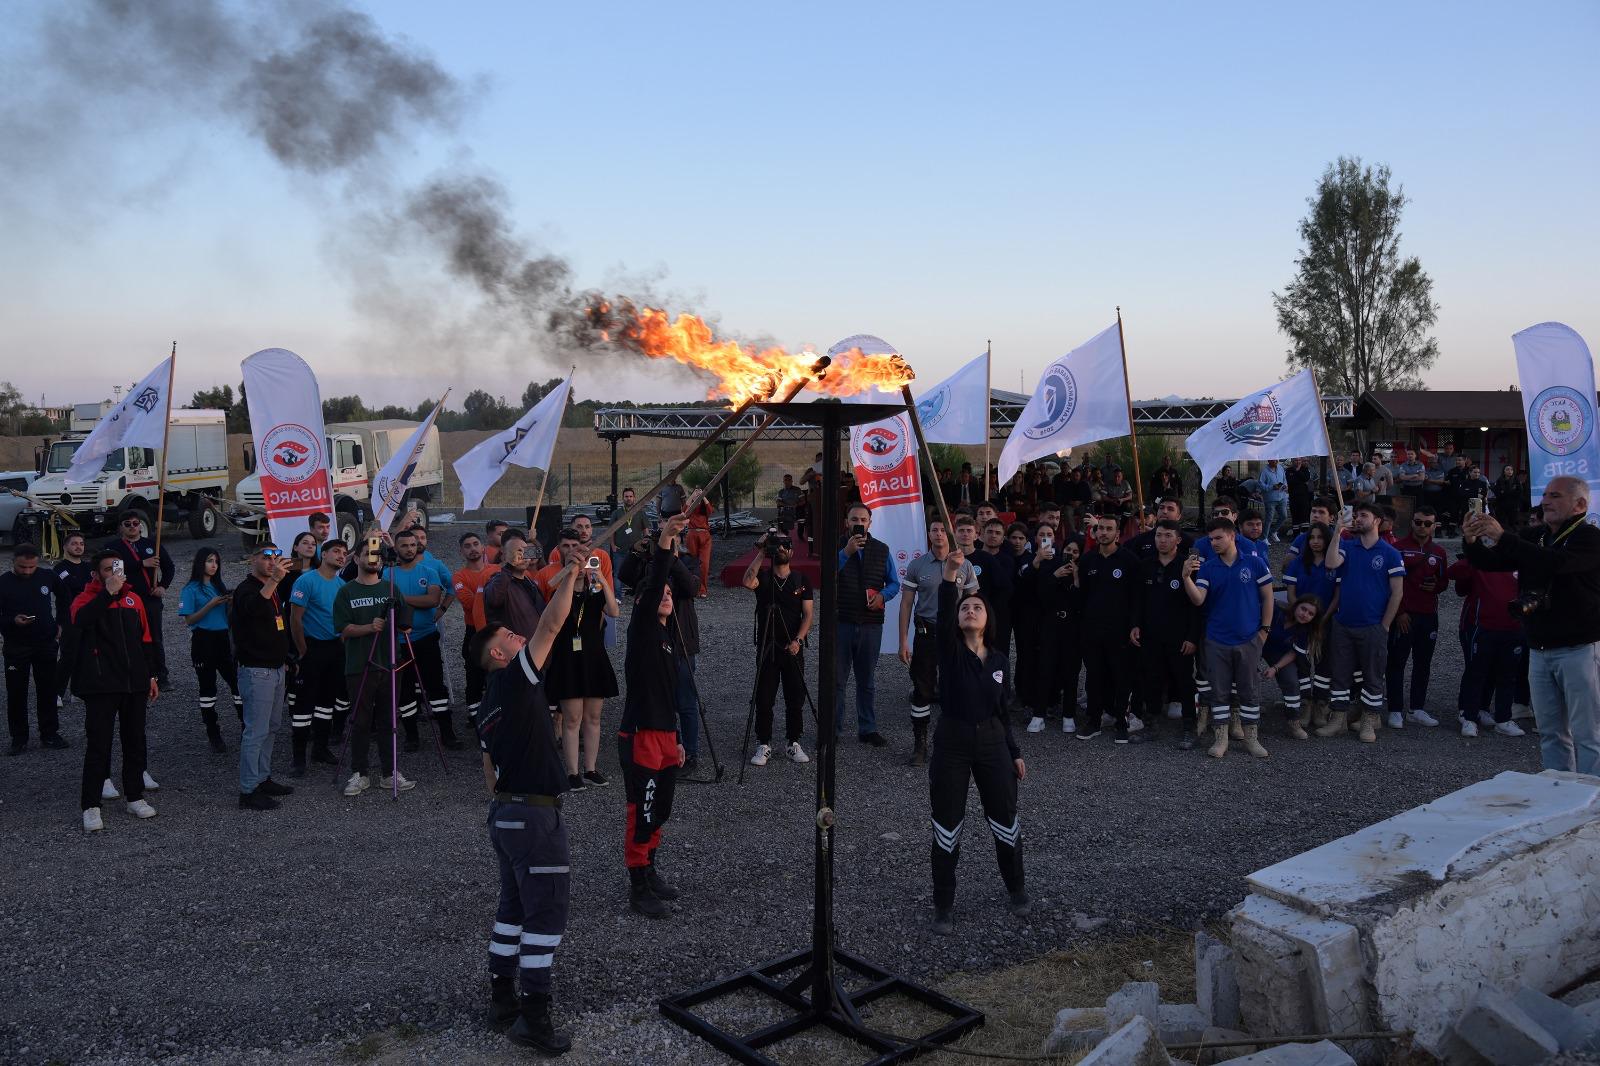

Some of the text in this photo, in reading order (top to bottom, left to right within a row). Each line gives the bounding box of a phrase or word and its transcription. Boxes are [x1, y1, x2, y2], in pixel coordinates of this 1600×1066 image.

[352, 596, 389, 607] WHY NO
[643, 778, 657, 823] AKUT
